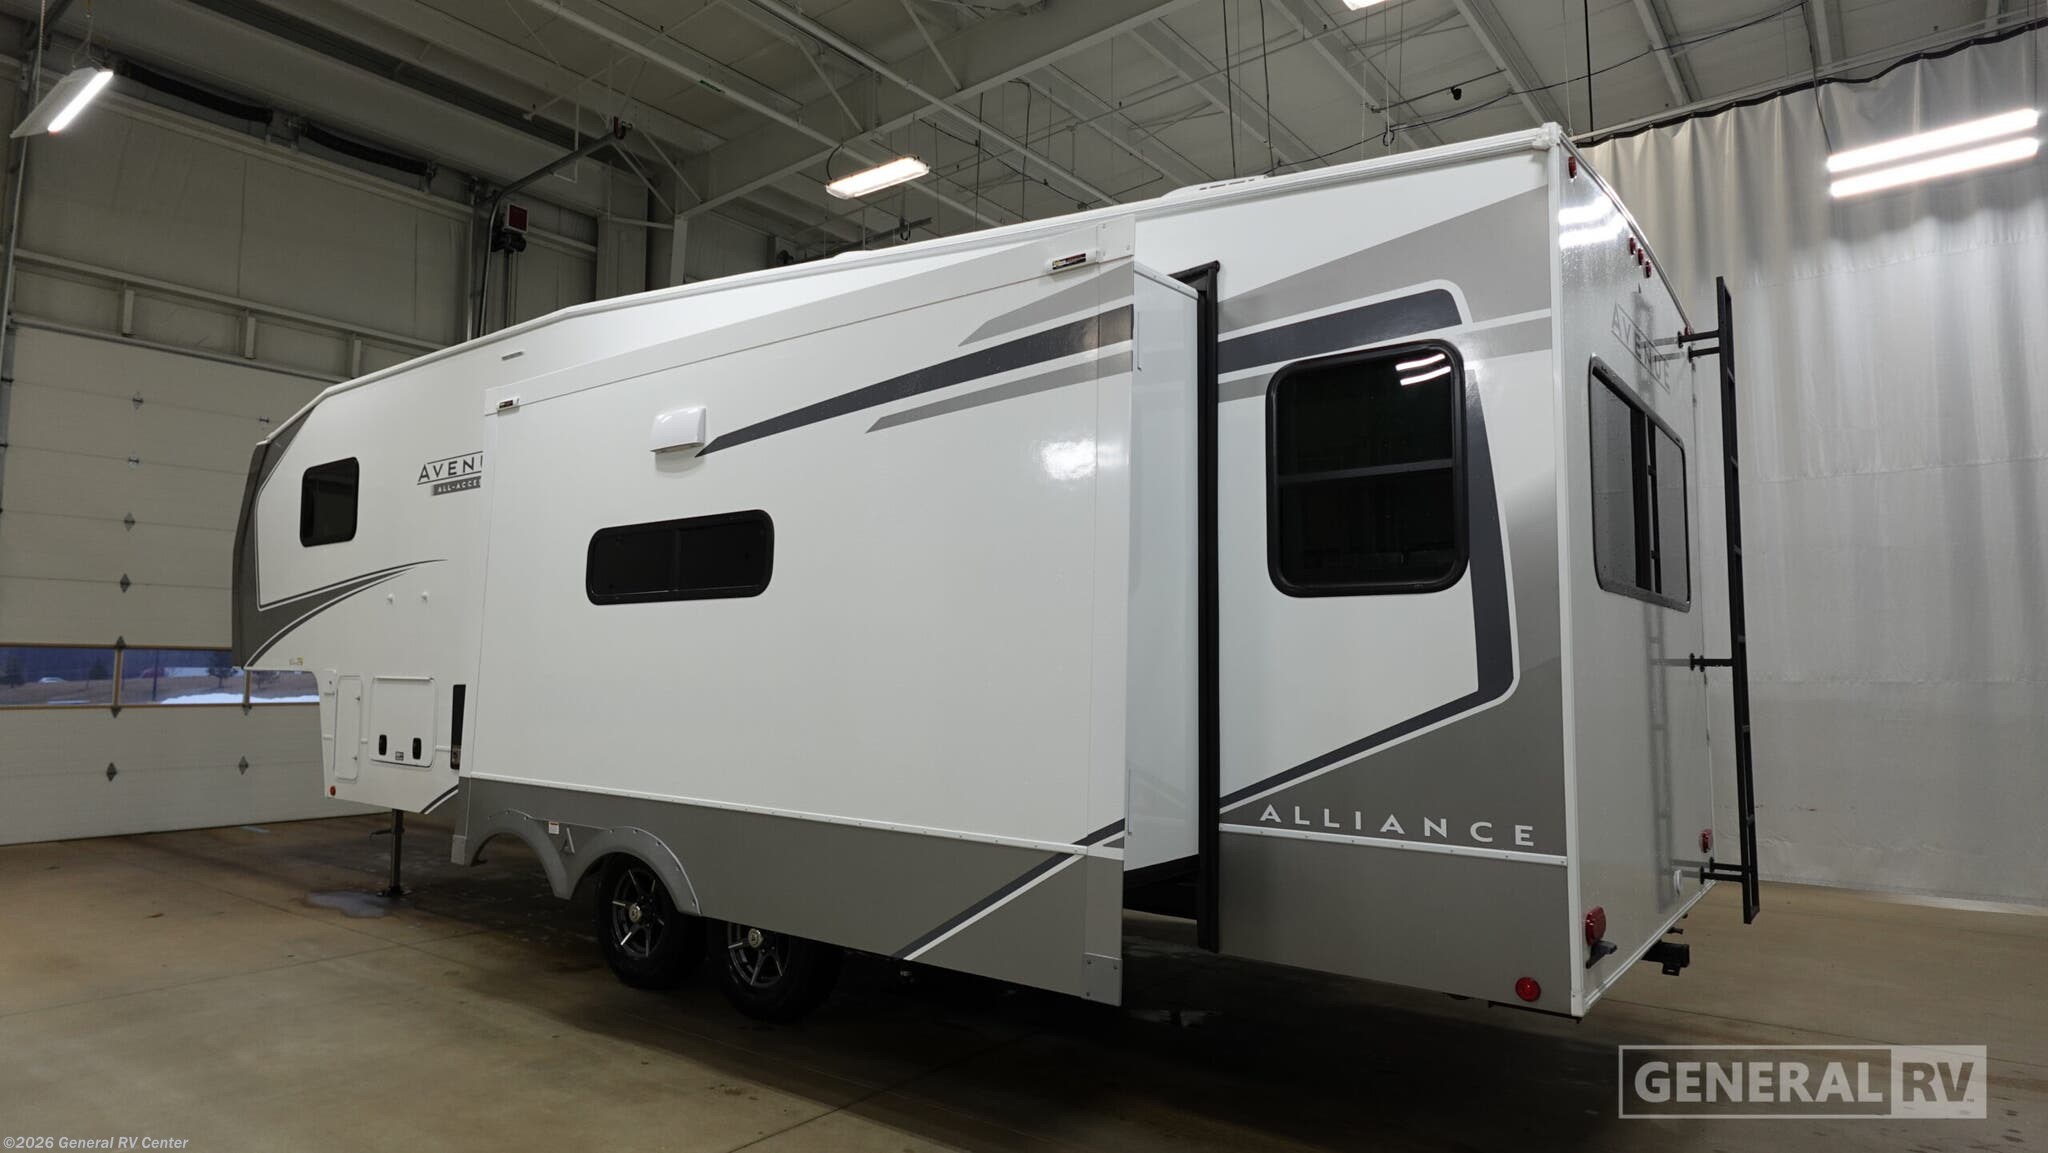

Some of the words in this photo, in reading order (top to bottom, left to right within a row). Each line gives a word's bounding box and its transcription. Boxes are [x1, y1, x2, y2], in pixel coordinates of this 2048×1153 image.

[418, 454, 483, 482] AVEN
[438, 479, 481, 493] ALL-ACCE
[1259, 803, 1534, 847] ALLIANCE
